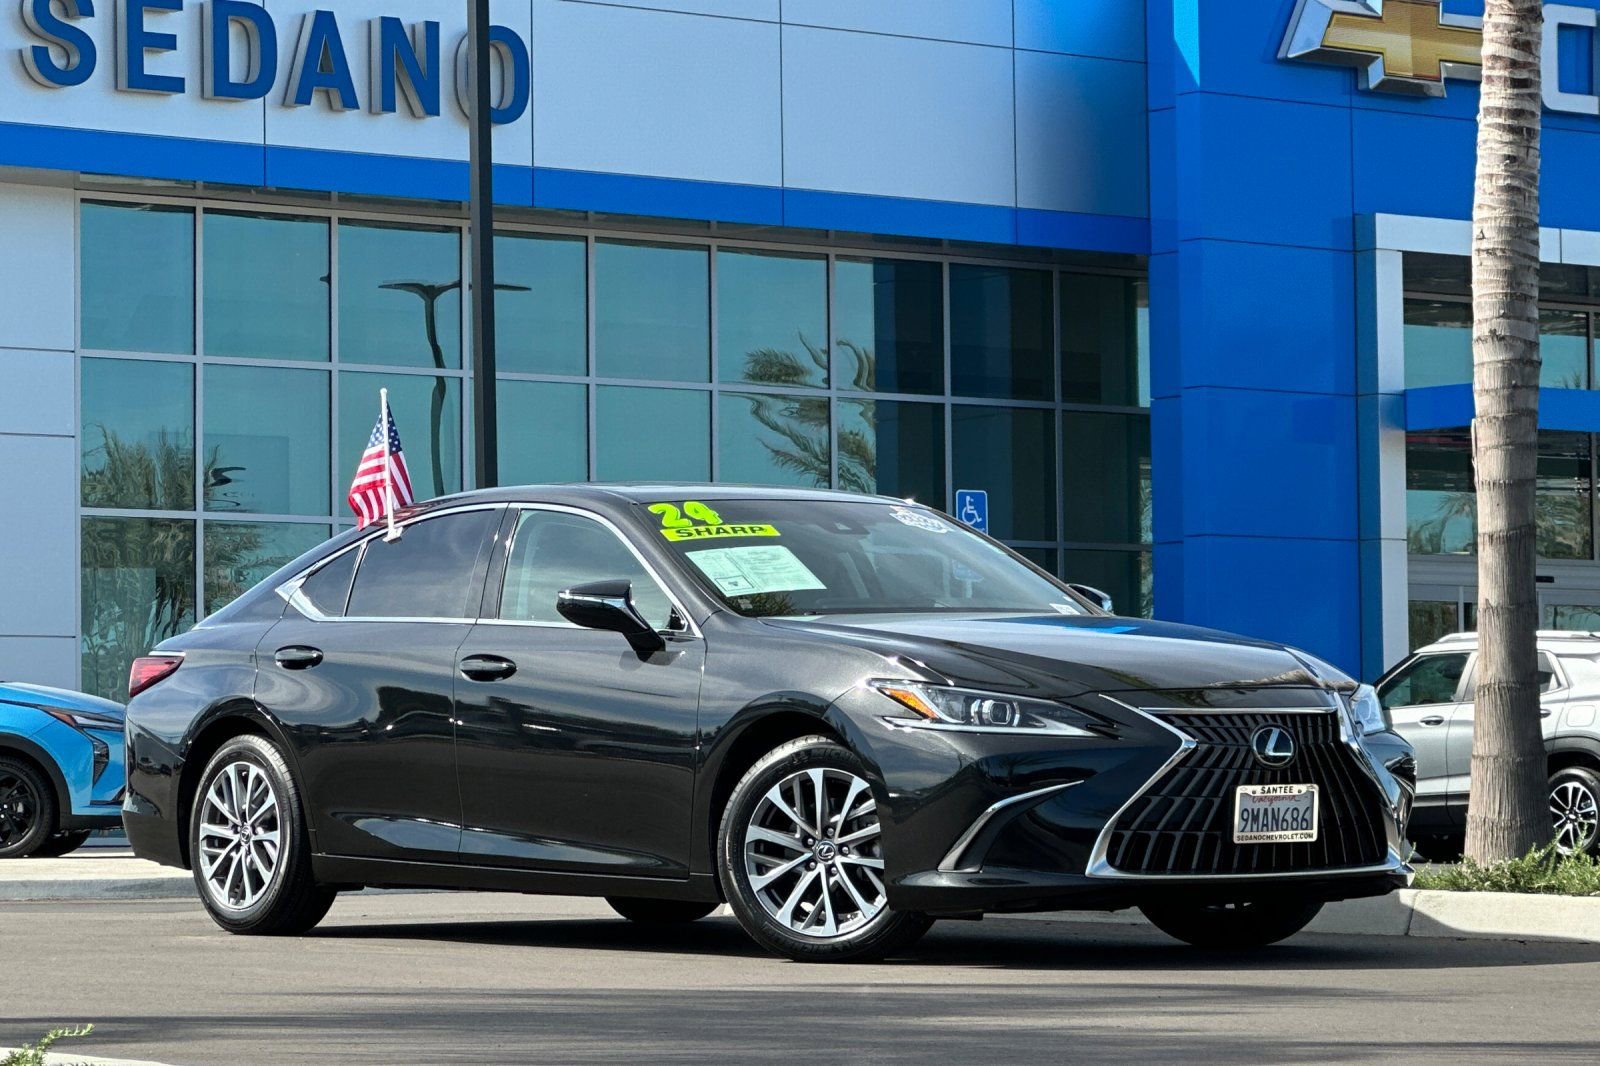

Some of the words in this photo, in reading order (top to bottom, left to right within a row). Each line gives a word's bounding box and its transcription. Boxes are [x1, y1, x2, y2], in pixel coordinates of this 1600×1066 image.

[22, 0, 530, 125] SEDANO
[647, 501, 723, 528] 24
[675, 526, 766, 538] SHARP
[1260, 786, 1294, 794] SANTEE
[1240, 806, 1310, 832] 9MAN686
[1236, 833, 1314, 841] SEDANOCHEVROLET.COM
